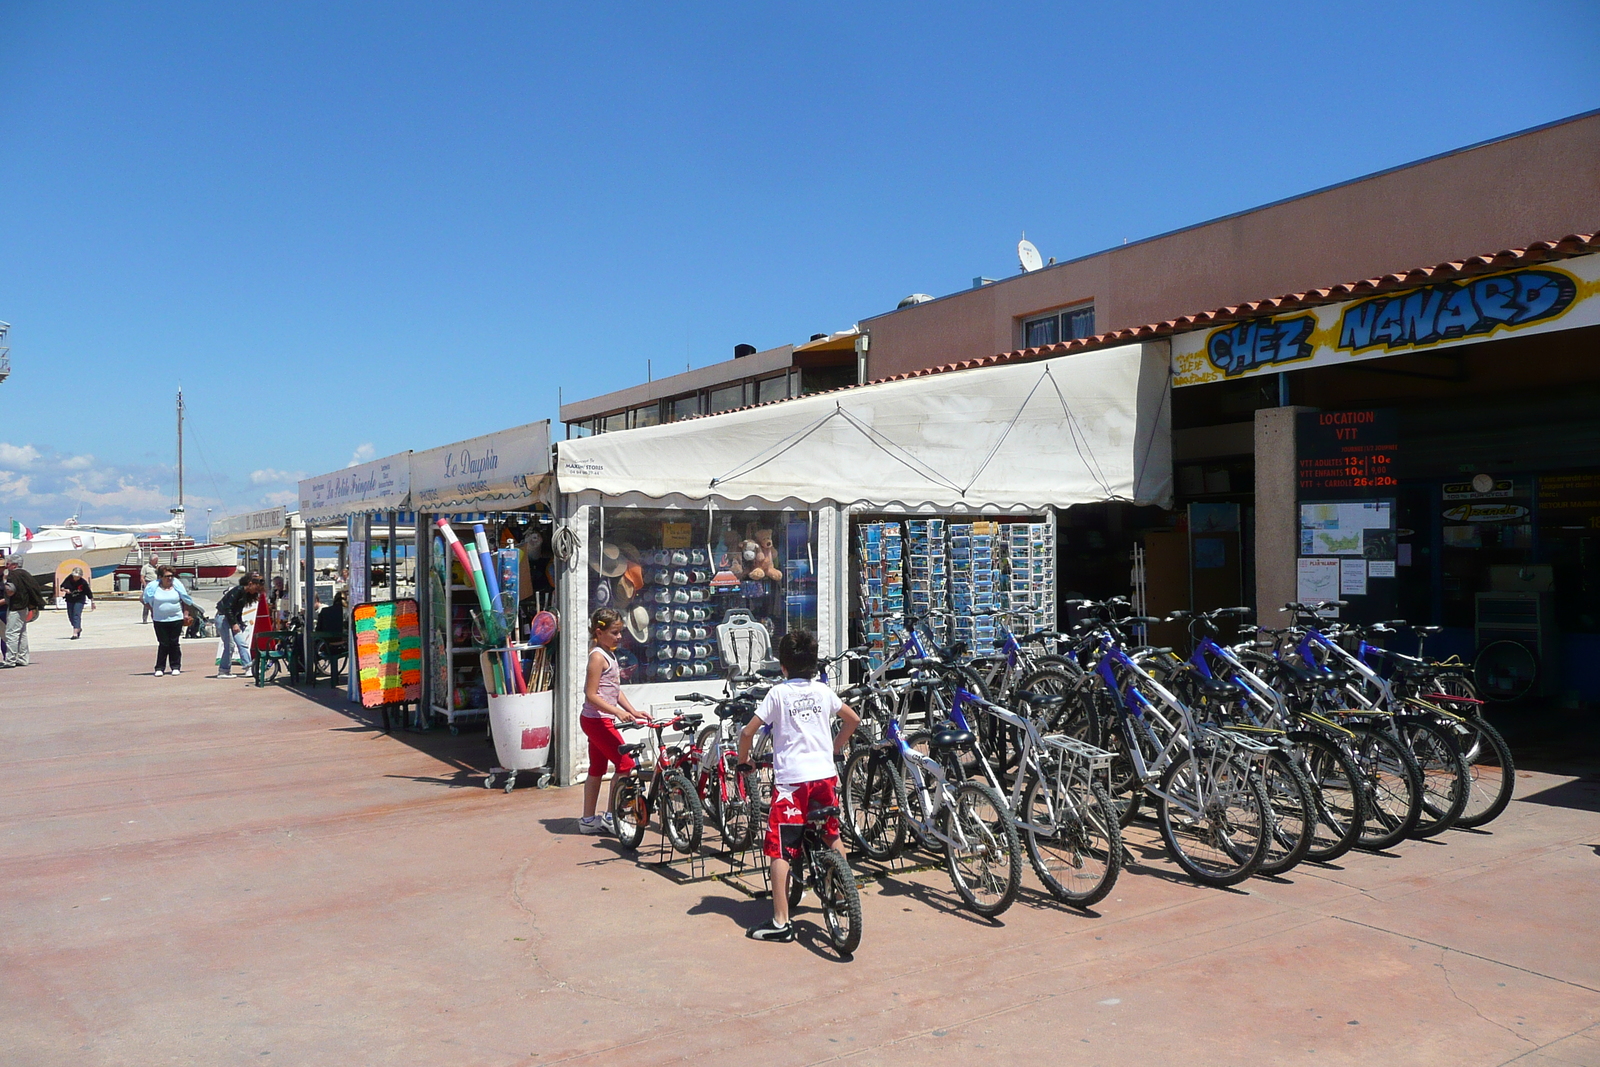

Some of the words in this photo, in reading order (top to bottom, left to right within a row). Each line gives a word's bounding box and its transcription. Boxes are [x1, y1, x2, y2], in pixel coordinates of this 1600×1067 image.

[1207, 315, 1312, 376] CHEZ
[1339, 269, 1574, 351] NANARD
[1319, 411, 1375, 425] LOCATION
[1336, 428, 1358, 440] VTT
[444, 453, 457, 479] Le
[460, 449, 498, 479] Dauphin
[1315, 458, 1343, 467] ADULTES
[1344, 457, 1364, 466] 13€
[1371, 455, 1391, 464] 10€
[1315, 469, 1343, 477] ENFANTS
[1344, 467, 1364, 476] 10€
[457, 480, 490, 496] SOUVENIRS
[1300, 480, 1313, 488] VTT
[1324, 479, 1352, 488] CARIOLE
[1353, 477, 1373, 487] 26€
[1377, 476, 1398, 486] 20€
[1539, 501, 1569, 509] RETOUR
[252, 511, 280, 529] PESCATORE
